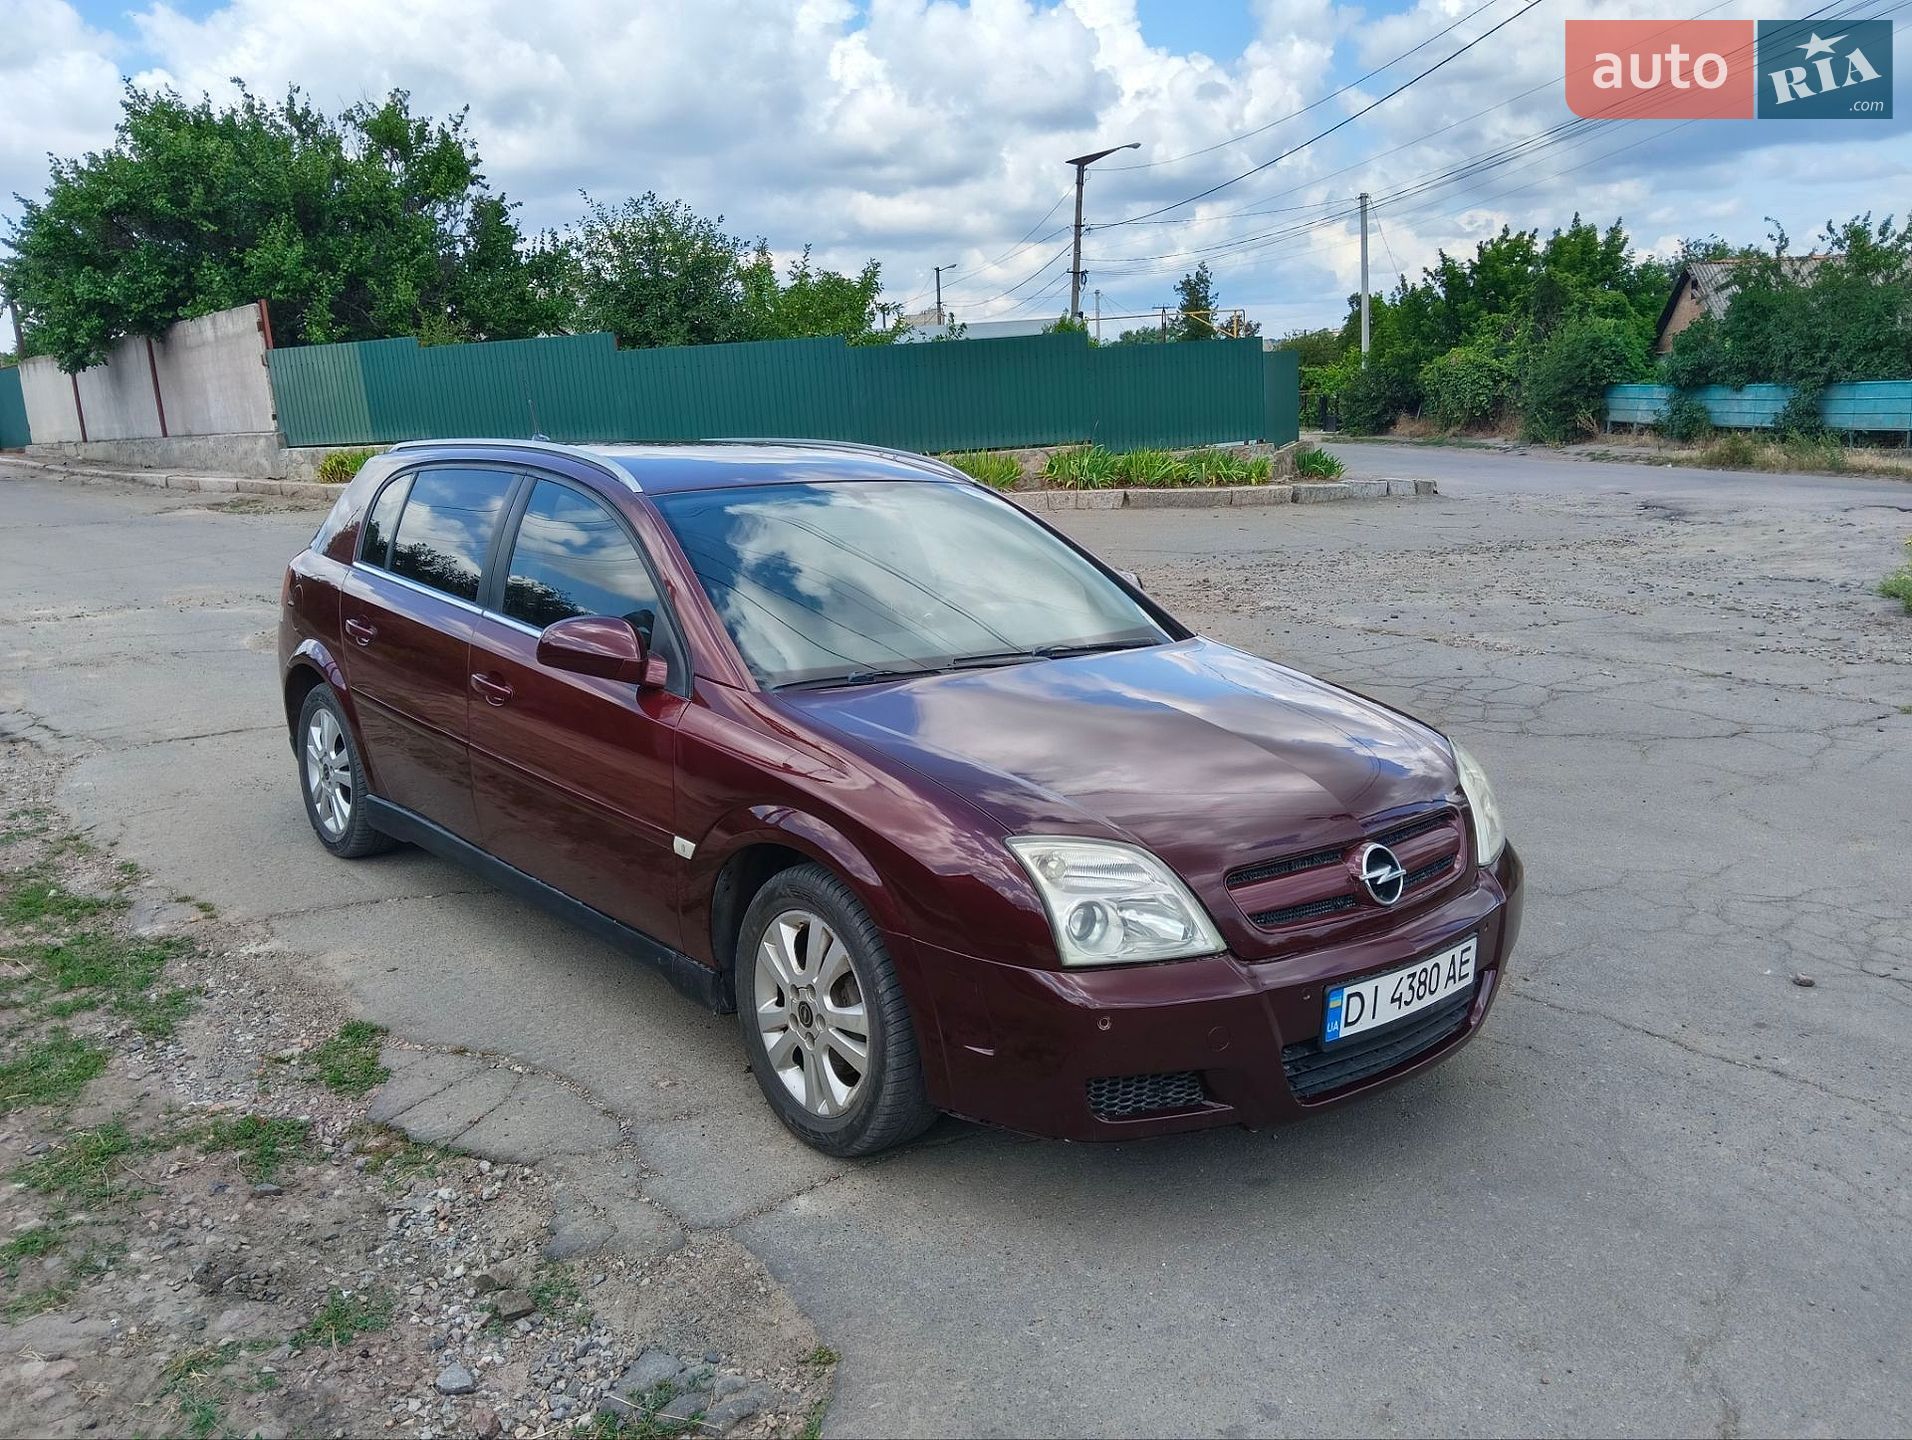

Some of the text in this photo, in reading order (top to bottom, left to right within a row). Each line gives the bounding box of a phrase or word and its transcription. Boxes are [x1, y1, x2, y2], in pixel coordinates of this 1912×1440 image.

[1344, 946, 1472, 1028] DI 4380 AE
[1327, 1021, 1339, 1033] UA
